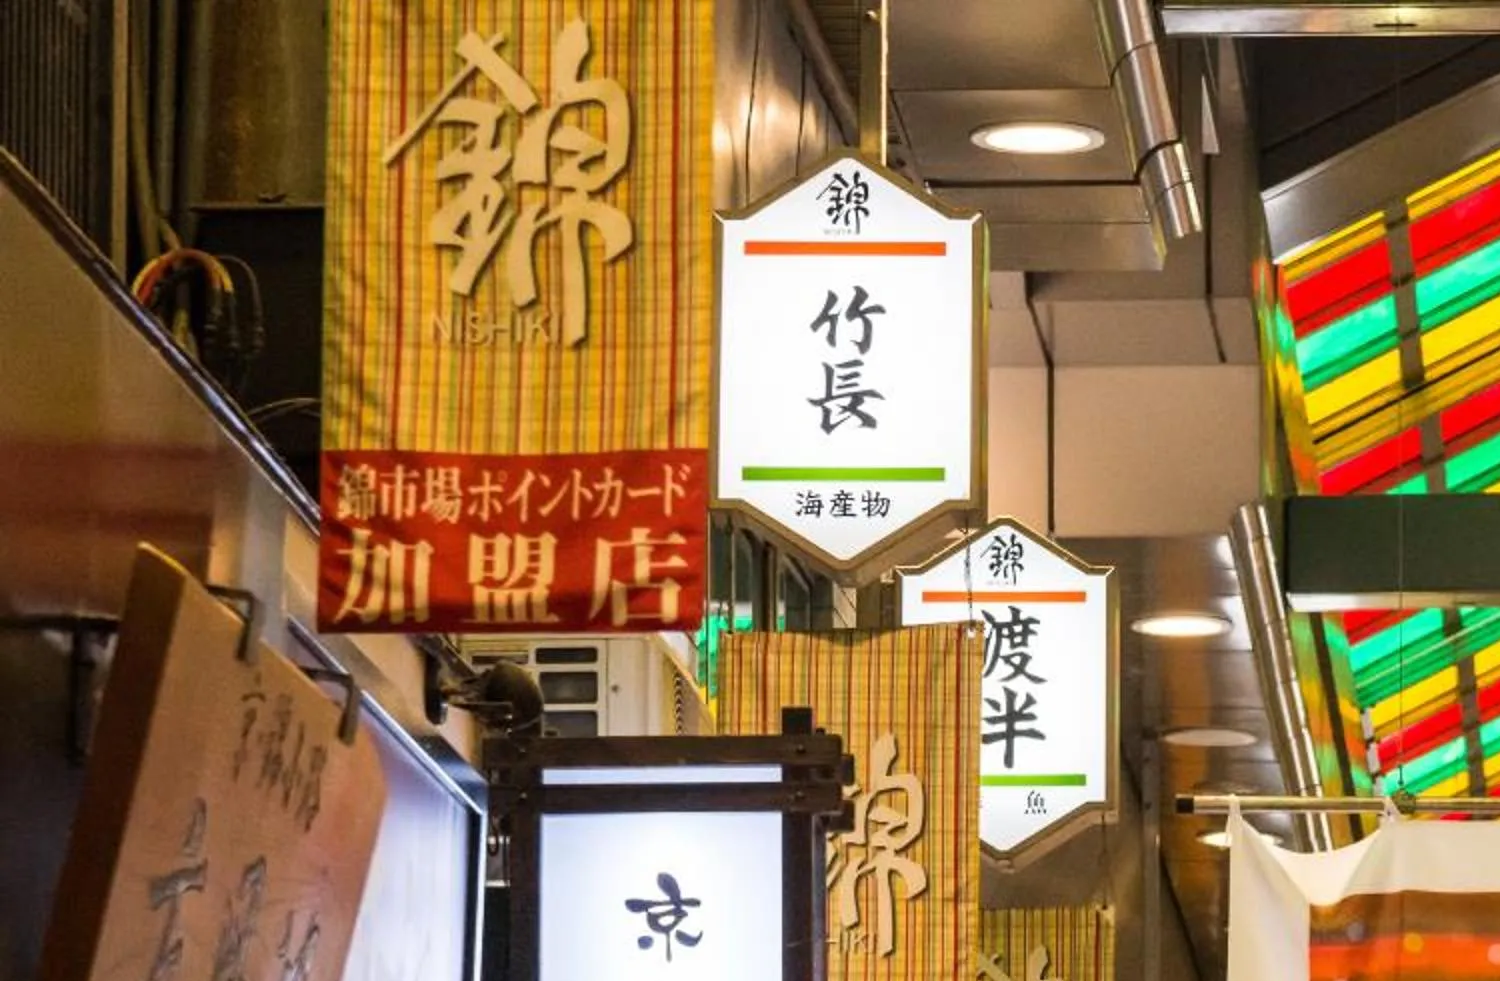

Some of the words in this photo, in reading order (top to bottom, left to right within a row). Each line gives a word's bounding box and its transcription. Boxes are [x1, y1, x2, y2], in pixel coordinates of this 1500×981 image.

[383, 16, 634, 350] 錦
[816, 170, 870, 235] 錦
[807, 285, 887, 435] 竹長
[336, 462, 691, 525] 錦市場ポイントカード
[795, 489, 891, 519] 海産物
[333, 527, 689, 629] 加盟店
[980, 533, 1025, 587] 錦
[981, 605, 1048, 769] 渡半
